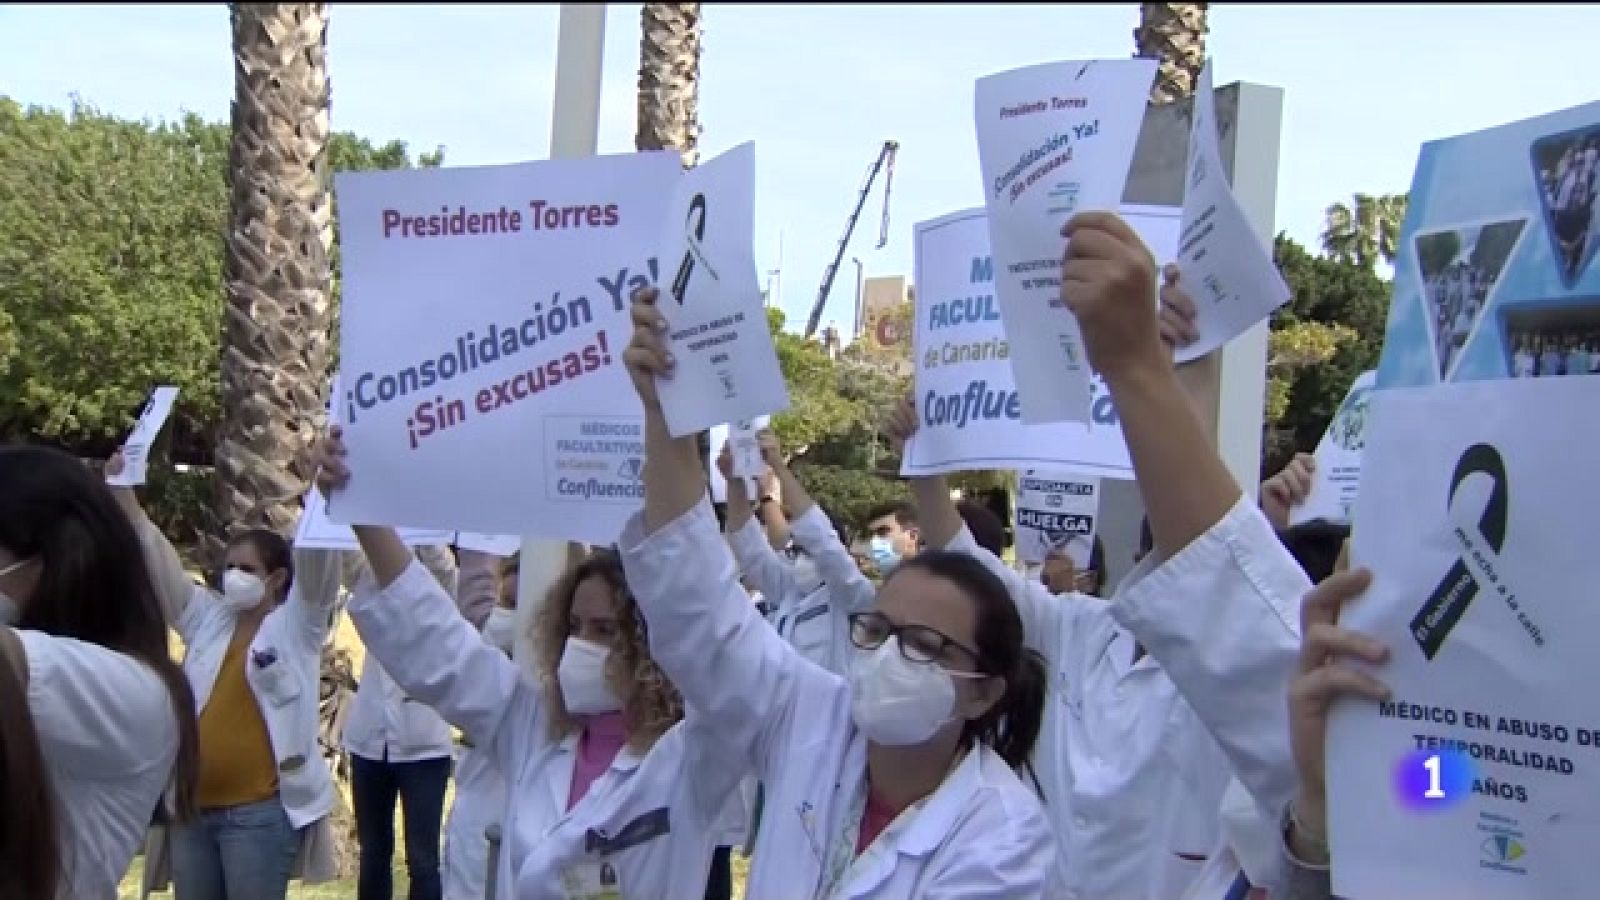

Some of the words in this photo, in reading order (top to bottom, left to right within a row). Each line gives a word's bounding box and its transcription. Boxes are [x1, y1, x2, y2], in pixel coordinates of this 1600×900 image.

[1071, 119, 1099, 140] Ya!
[382, 206, 521, 238] Presidente
[530, 200, 619, 230] Torres
[346, 292, 593, 423] ¡Consolidación
[923, 343, 939, 368] de
[942, 336, 1009, 366] Canaria
[406, 395, 466, 449] ¡Sin
[475, 330, 613, 414] excusas!
[1019, 509, 1090, 533] HUELGA
[1379, 699, 1458, 725] MÉDICO
[1463, 712, 1490, 730] EN
[1497, 716, 1569, 743] ABUSO
[1413, 734, 1574, 775] TEMPORALIDAD
[1471, 777, 1528, 803] AÑOS
